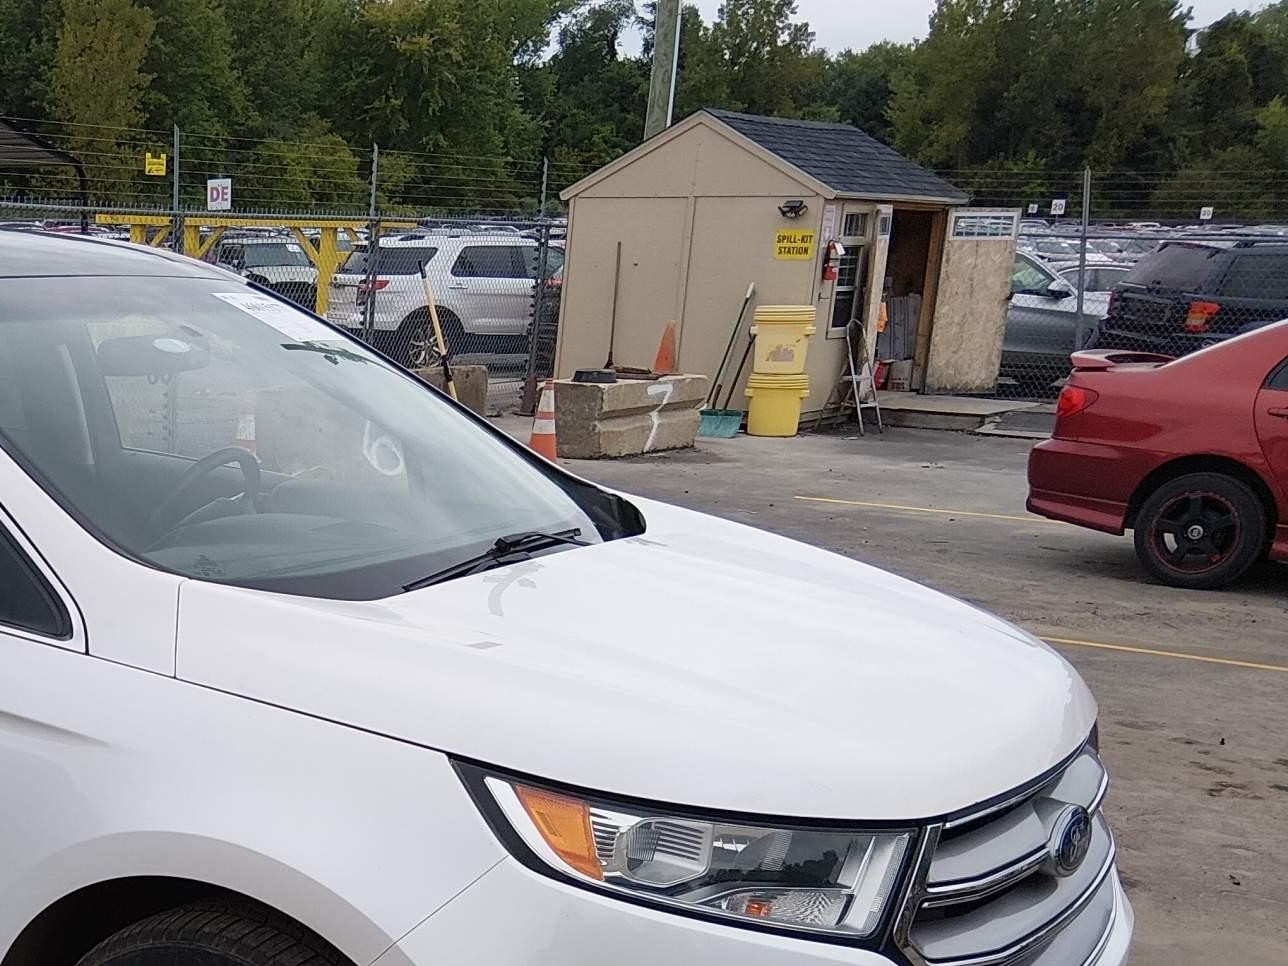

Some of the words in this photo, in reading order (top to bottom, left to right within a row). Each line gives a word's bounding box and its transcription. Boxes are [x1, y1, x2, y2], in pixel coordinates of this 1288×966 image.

[210, 186, 229, 203] DE
[1052, 202, 1064, 211] 20
[776, 234, 814, 244] SPILL-KIT
[777, 246, 809, 255] STATION
